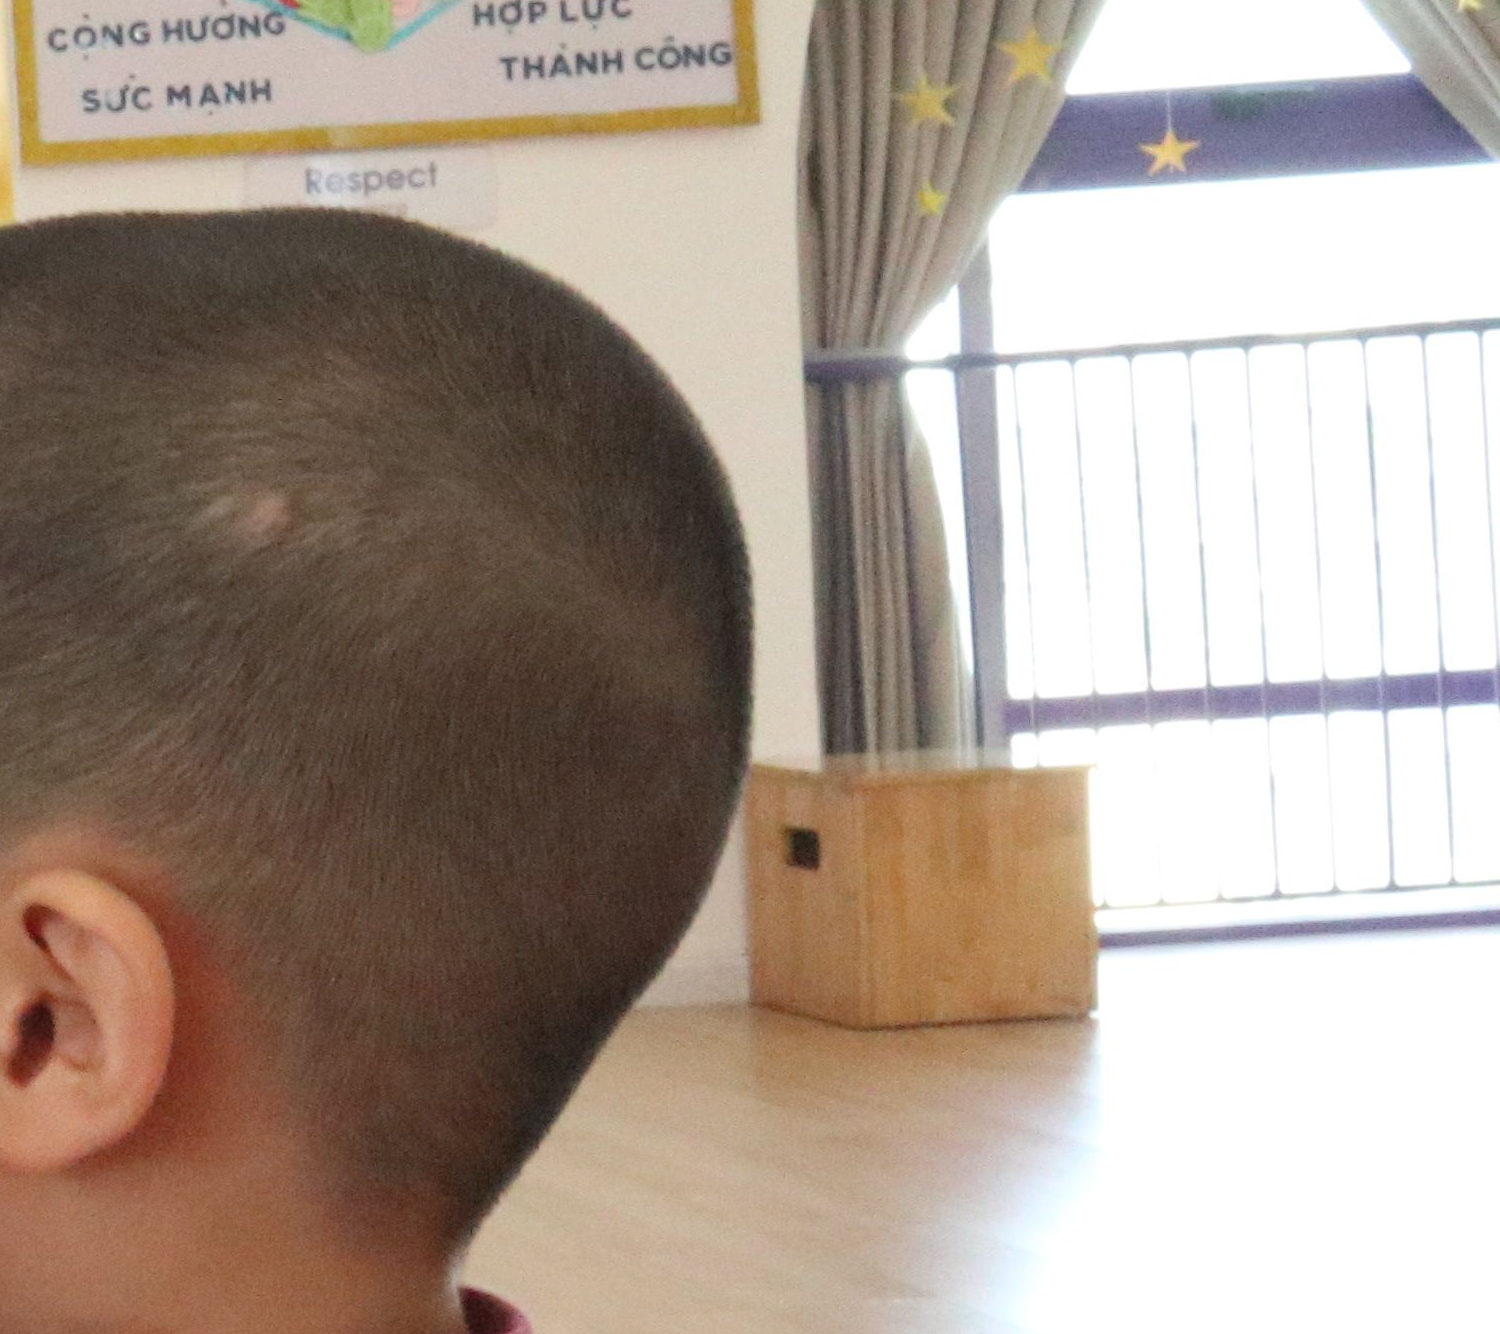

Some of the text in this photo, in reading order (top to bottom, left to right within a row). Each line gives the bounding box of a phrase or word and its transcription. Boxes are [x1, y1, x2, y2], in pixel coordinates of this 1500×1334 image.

[635, 35, 733, 71] CÔNG
[166, 78, 272, 116] MẠNH
[304, 160, 438, 197] Respect
